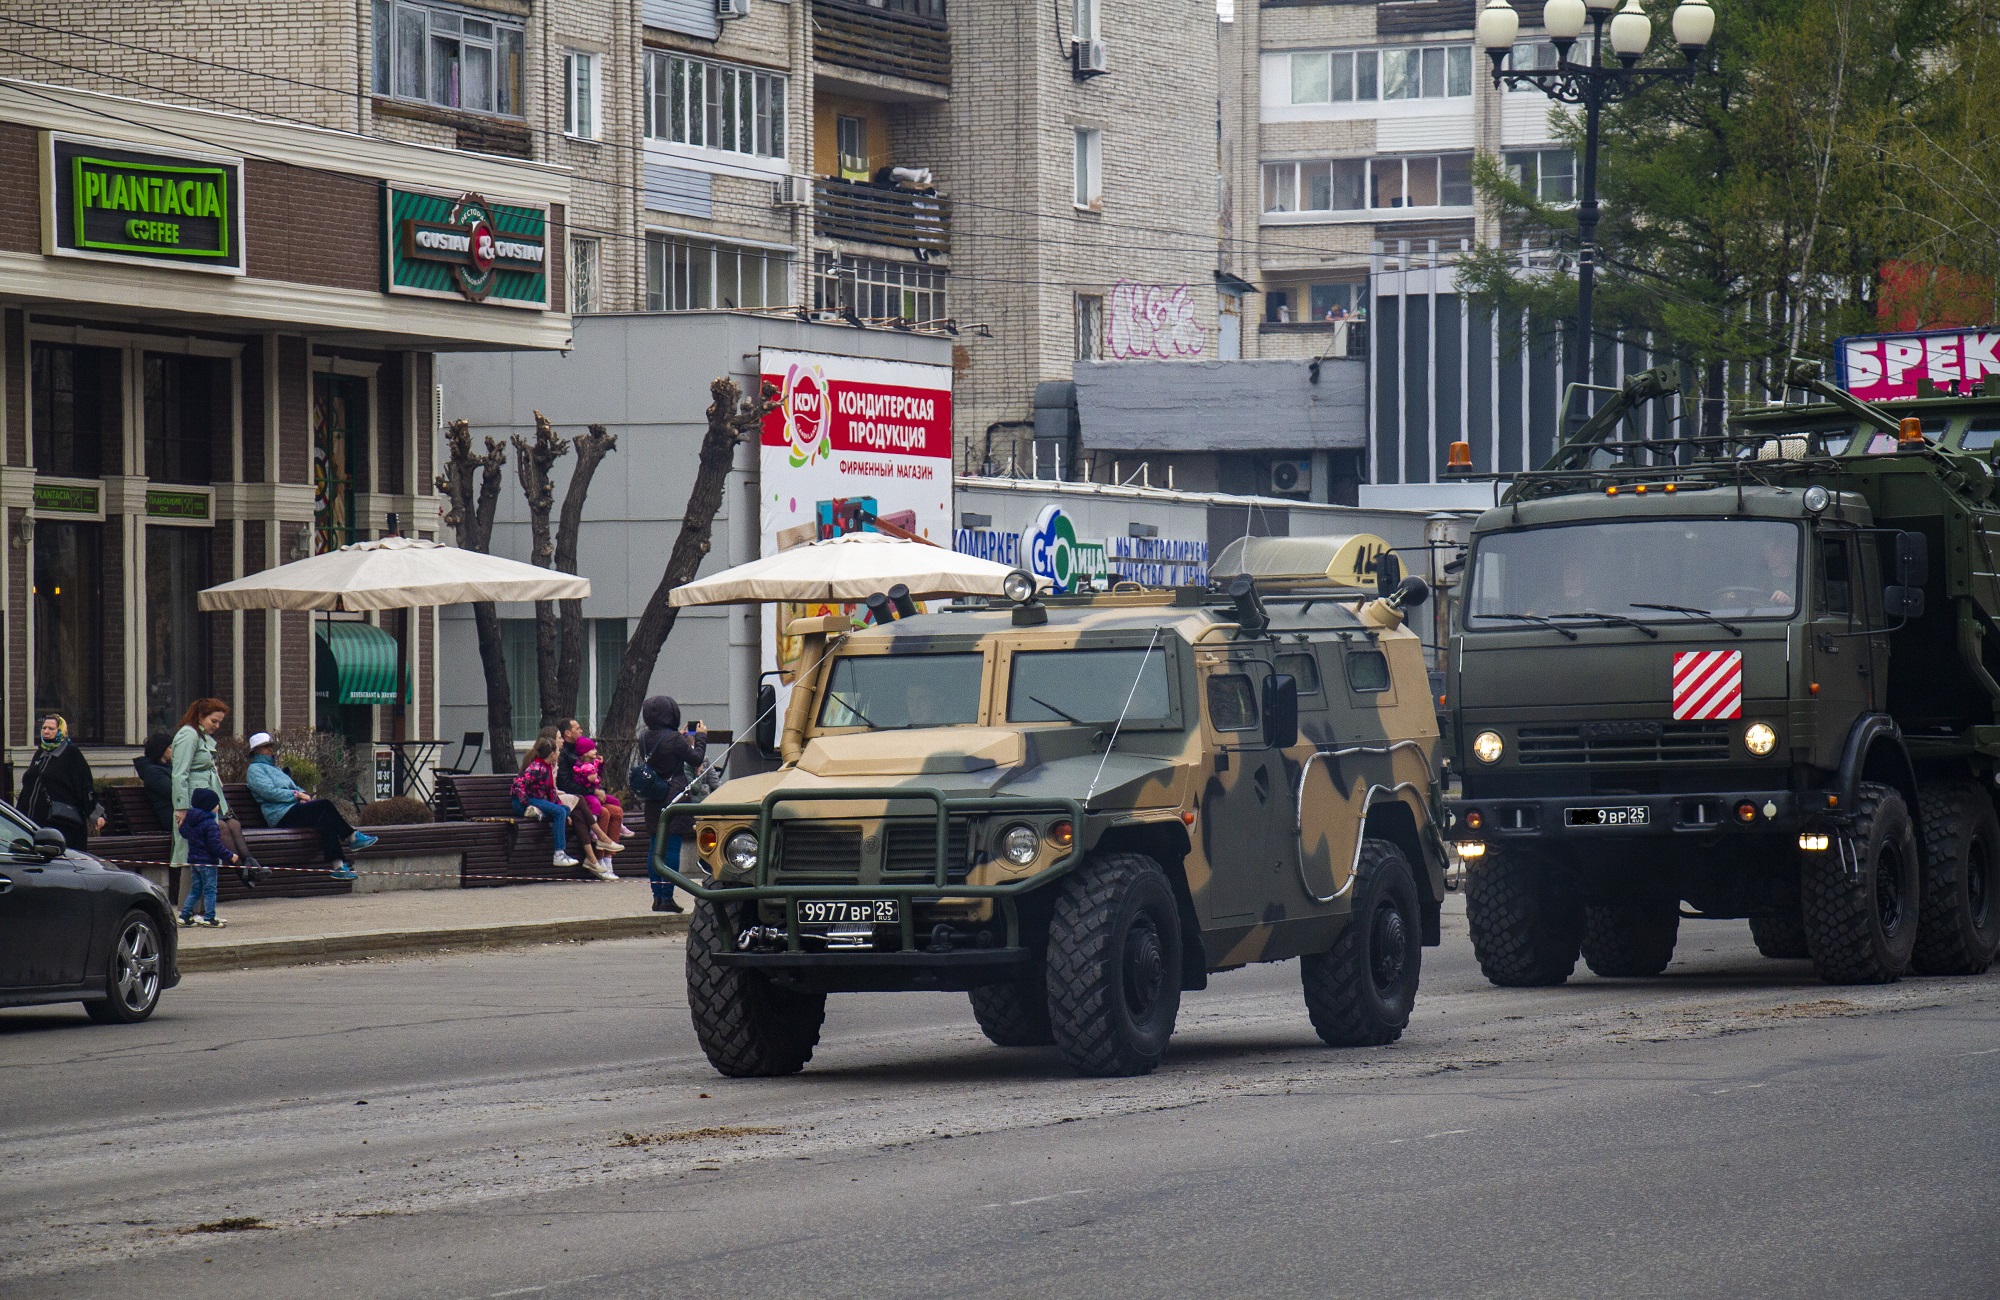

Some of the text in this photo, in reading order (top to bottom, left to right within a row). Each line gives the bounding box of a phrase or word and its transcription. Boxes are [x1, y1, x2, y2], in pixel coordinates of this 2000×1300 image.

[84, 171, 221, 218] PLANTACIA
[461, 208, 486, 225] РЕСТОРА
[126, 218, 180, 244] COFFEE
[415, 231, 544, 262] GUSTAV & GUSTAV
[1846, 332, 2000, 389] БРЕК
[795, 393, 819, 412] KDV
[838, 391, 934, 421] КОНДИТЕРСКАЯ
[848, 421, 926, 451] ПРОДУКЦИЯ
[839, 459, 933, 481] ФИРМЕННЫЙ МАГАЗИН
[1116, 537, 1208, 562] МЫ КОНТРОЛИРУЕМ
[1116, 562, 1164, 585] КАЧЕСТВО
[1170, 565, 1177, 584] И
[1581, 721, 1661, 737] КАМАЗ
[1630, 808, 1645, 819] 25
[805, 903, 847, 921] 9977
[876, 902, 893, 916] 25
